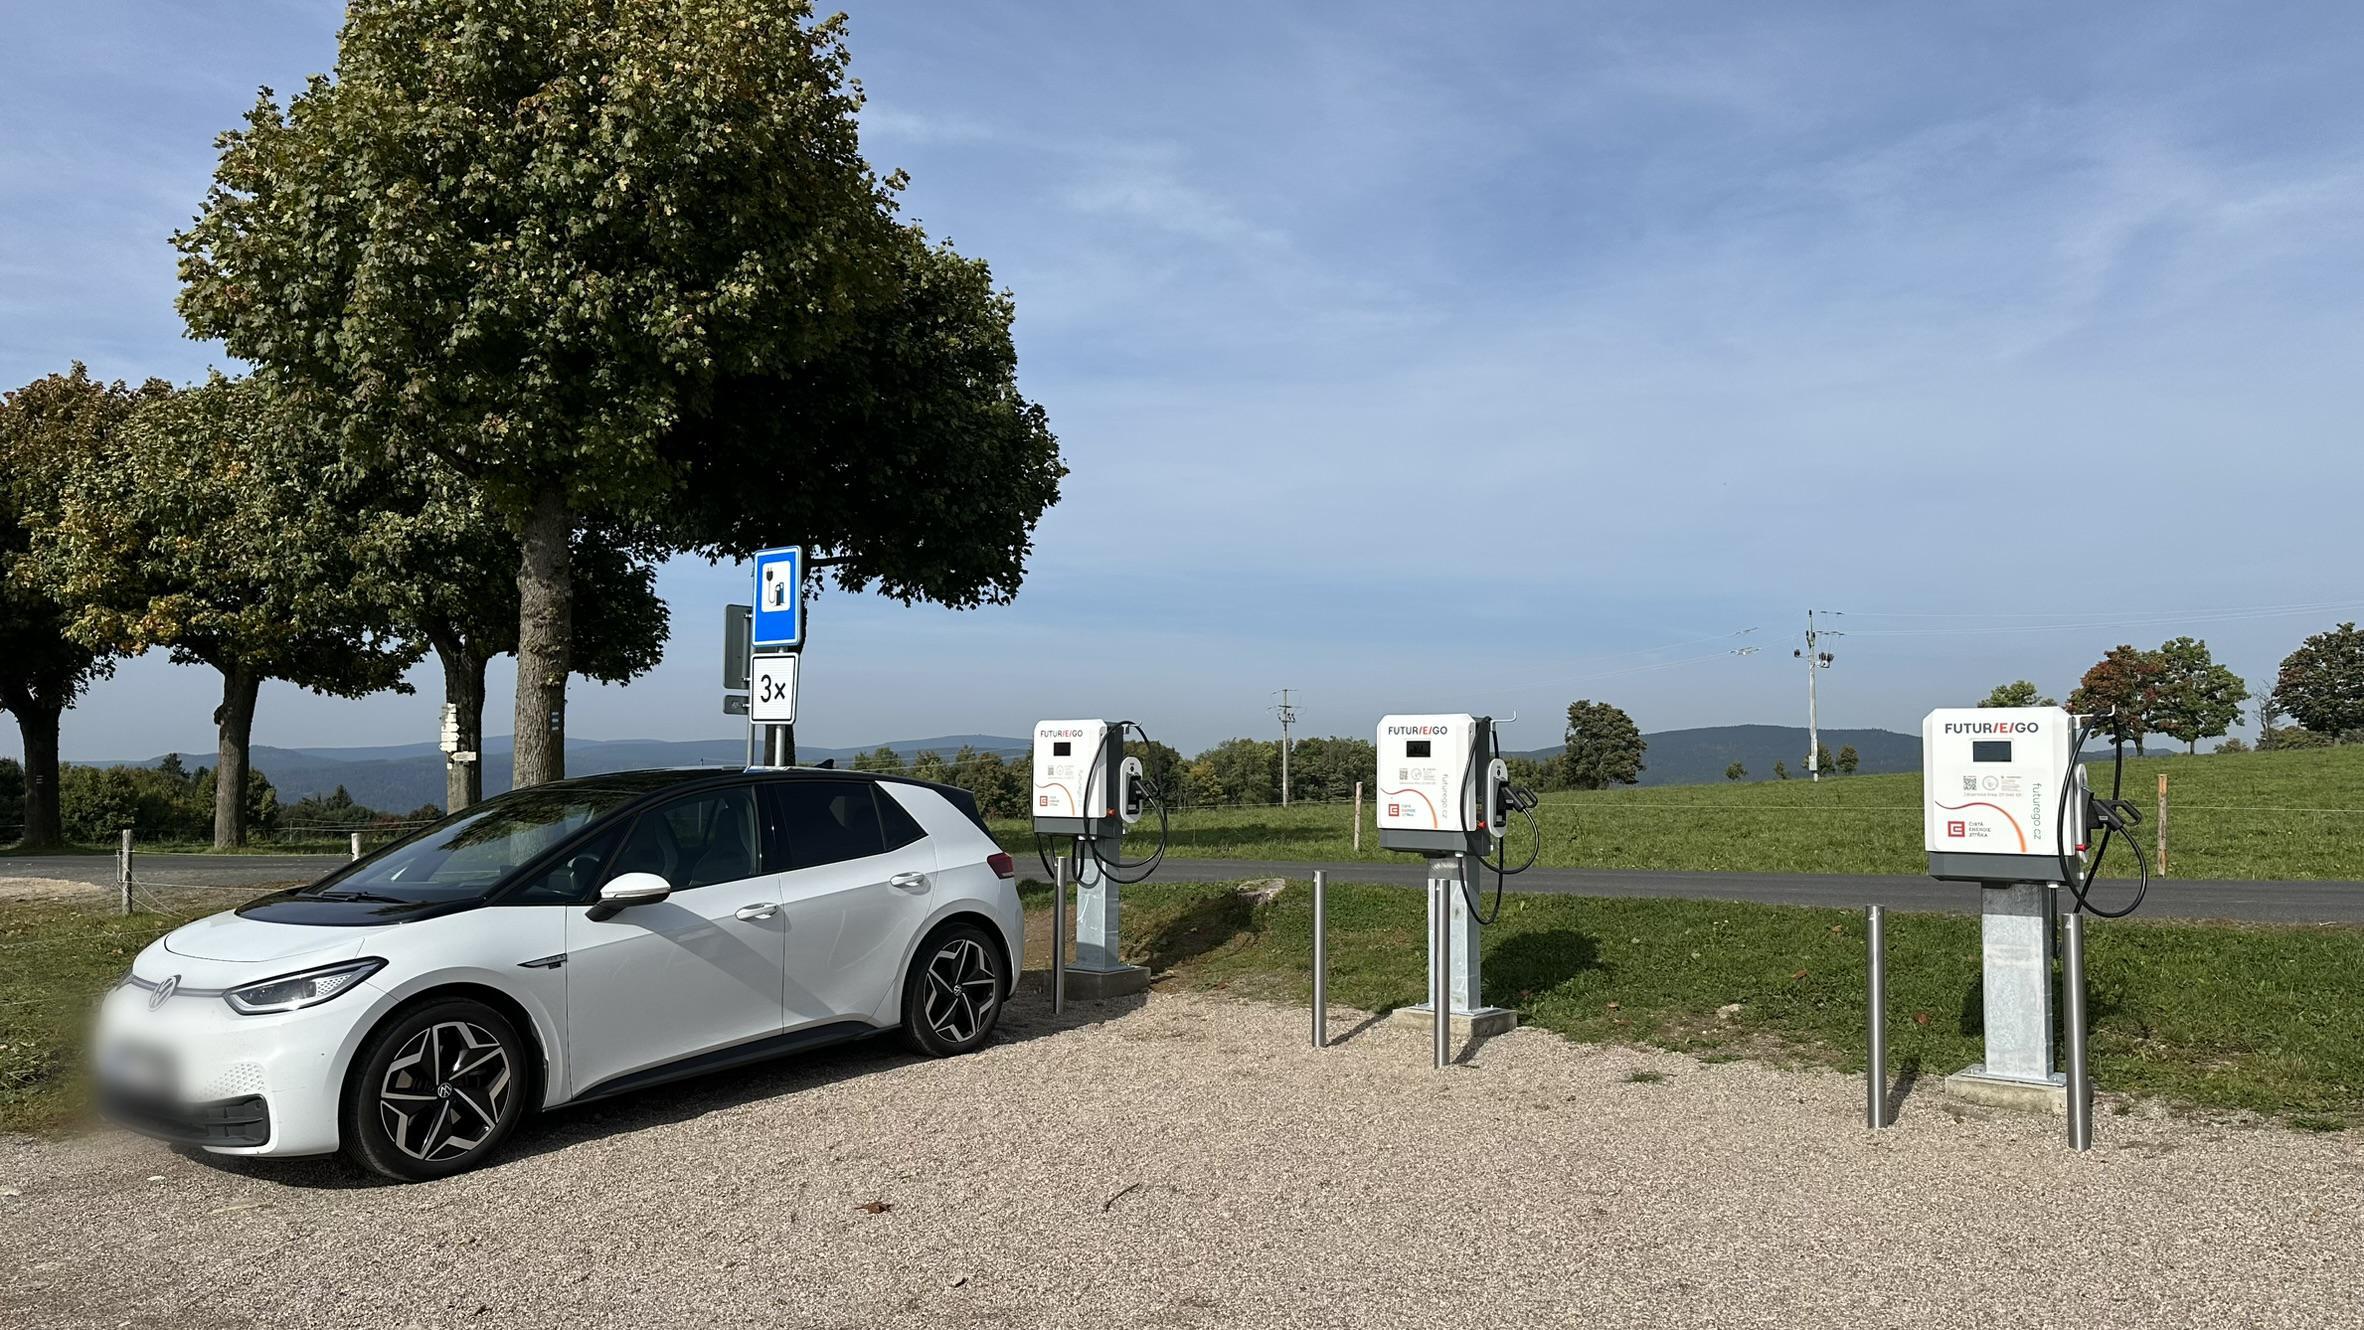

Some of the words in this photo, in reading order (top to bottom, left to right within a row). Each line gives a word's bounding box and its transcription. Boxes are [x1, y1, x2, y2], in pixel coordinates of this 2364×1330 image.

[760, 674, 786, 703] 3x
[1040, 730, 1083, 738] FUTUR/E/GO
[1388, 726, 1448, 735] FUTUR/E/GO
[1945, 722, 2039, 734] FUTUR/E/GO
[2031, 783, 2042, 840] futuregocz
